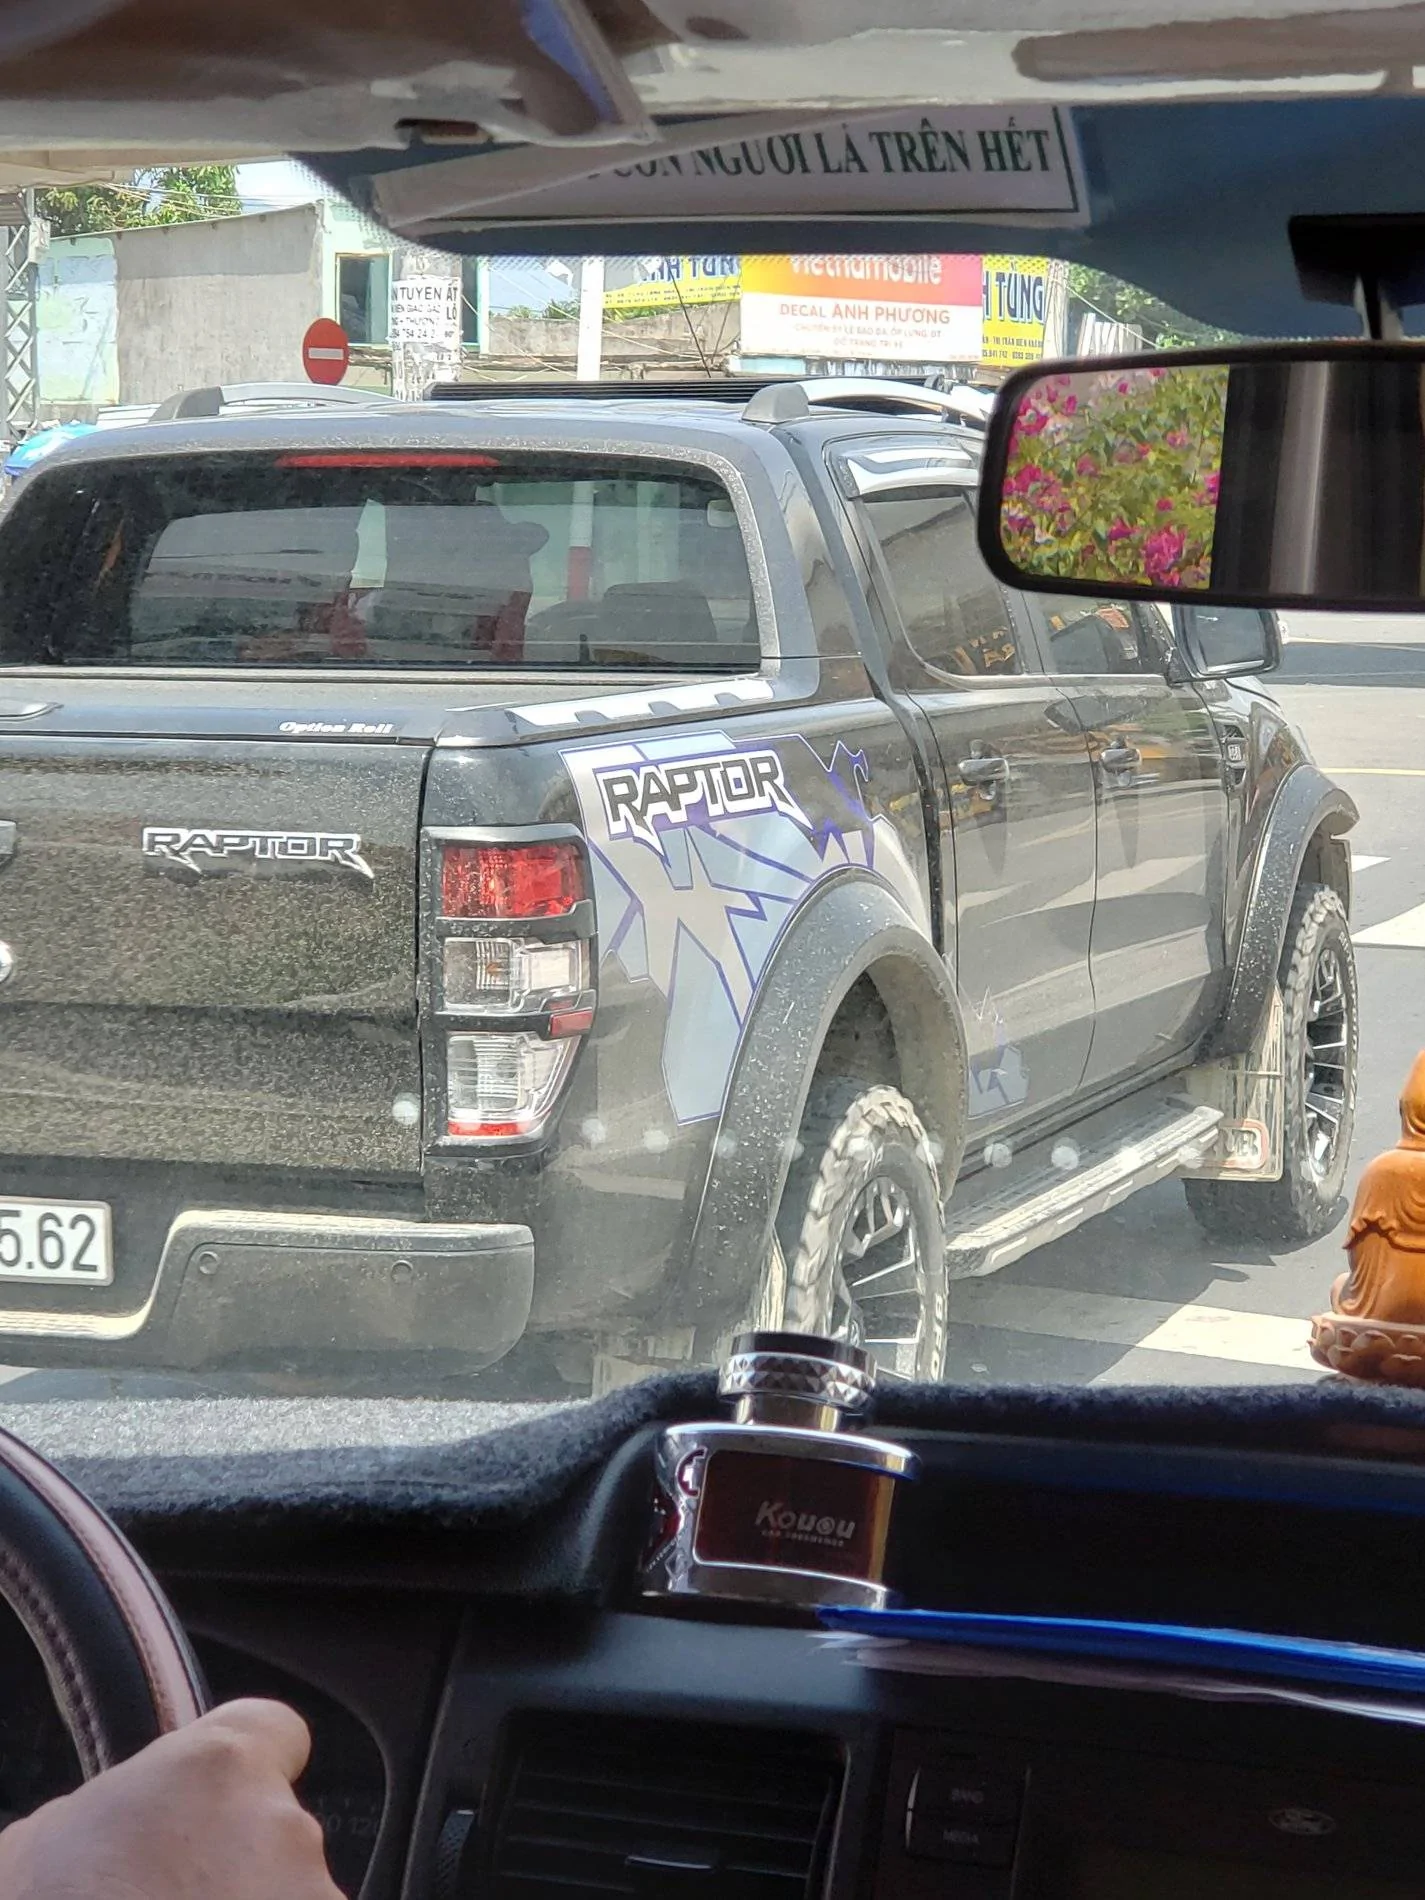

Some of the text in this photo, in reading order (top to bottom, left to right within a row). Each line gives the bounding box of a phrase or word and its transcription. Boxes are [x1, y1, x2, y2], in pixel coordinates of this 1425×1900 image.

[868, 117, 972, 173] TRÊN
[976, 117, 1050, 172] HẾT
[779, 303, 826, 318] DECAL
[875, 307, 950, 324] PHƯƠNG
[595, 750, 812, 854] RAPTOR
[143, 827, 373, 878] RAPTOR
